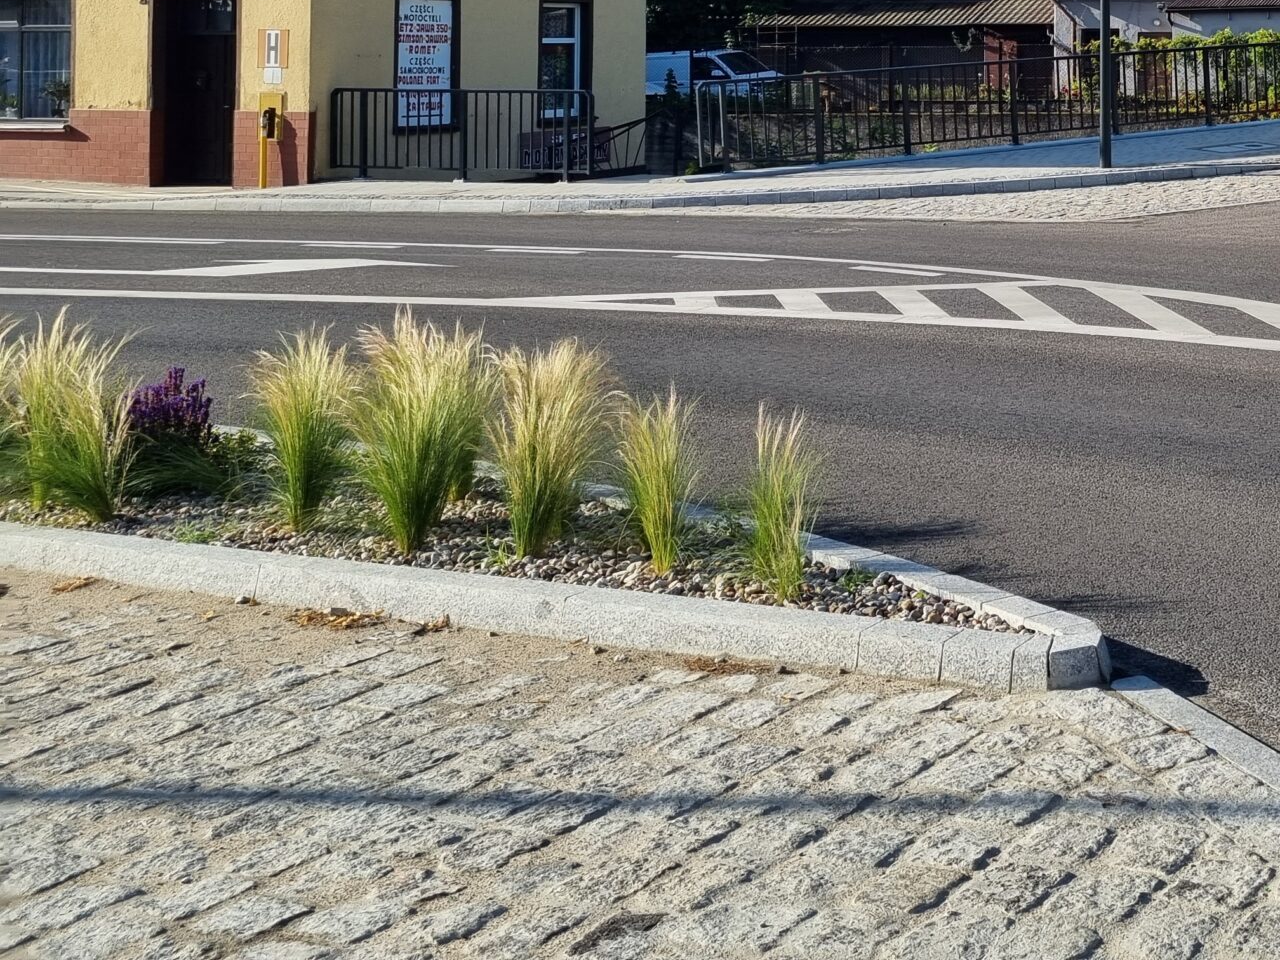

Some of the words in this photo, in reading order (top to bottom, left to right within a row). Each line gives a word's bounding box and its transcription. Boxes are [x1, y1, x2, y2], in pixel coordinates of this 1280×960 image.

[409, 3, 434, 14] CZĘŚCI
[408, 45, 437, 54] ROMET
[409, 56, 434, 66] CZĘŚCI
